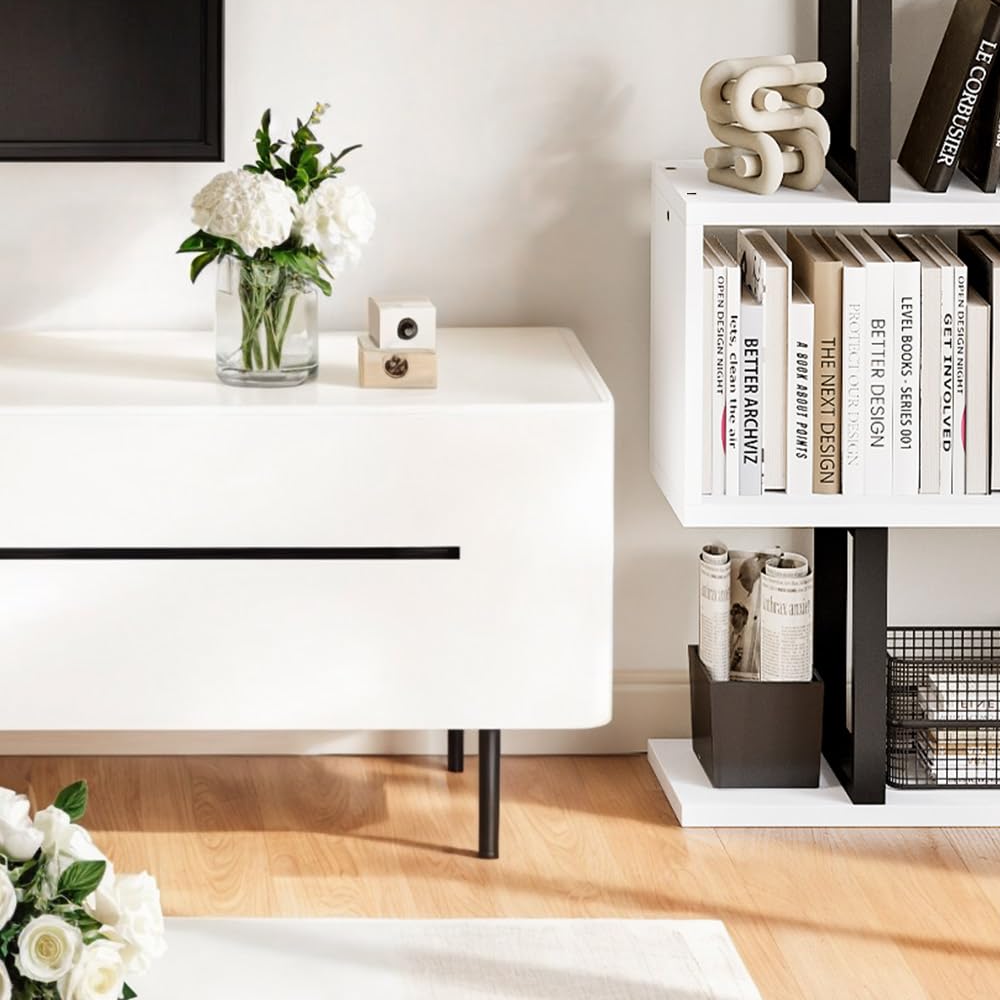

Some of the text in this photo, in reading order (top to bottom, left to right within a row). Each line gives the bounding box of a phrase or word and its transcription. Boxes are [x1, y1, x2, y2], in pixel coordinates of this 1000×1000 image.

[937, 39, 998, 166] LE CORBUSIER
[717, 275, 725, 308] OPEN
[730, 316, 738, 346] lets,
[901, 297, 912, 332] LEVEL
[957, 311, 965, 356] DESIGN
[796, 353, 808, 380] BOOK
[901, 336, 912, 376] BOOKS
[744, 339, 758, 463] BETTER ARCHVIZ
[796, 384, 808, 417] ABOUT
[847, 304, 860, 466] PROTECT OUR DESIGN
[871, 319, 885, 447] BETTER DESIGN
[943, 314, 952, 452] GET INVOLVED
[820, 337, 835, 484] THE NEXT DESIGN
[900, 387, 912, 426] SERIES
[796, 422, 807, 459] POINTS
[900, 429, 912, 449] 001
